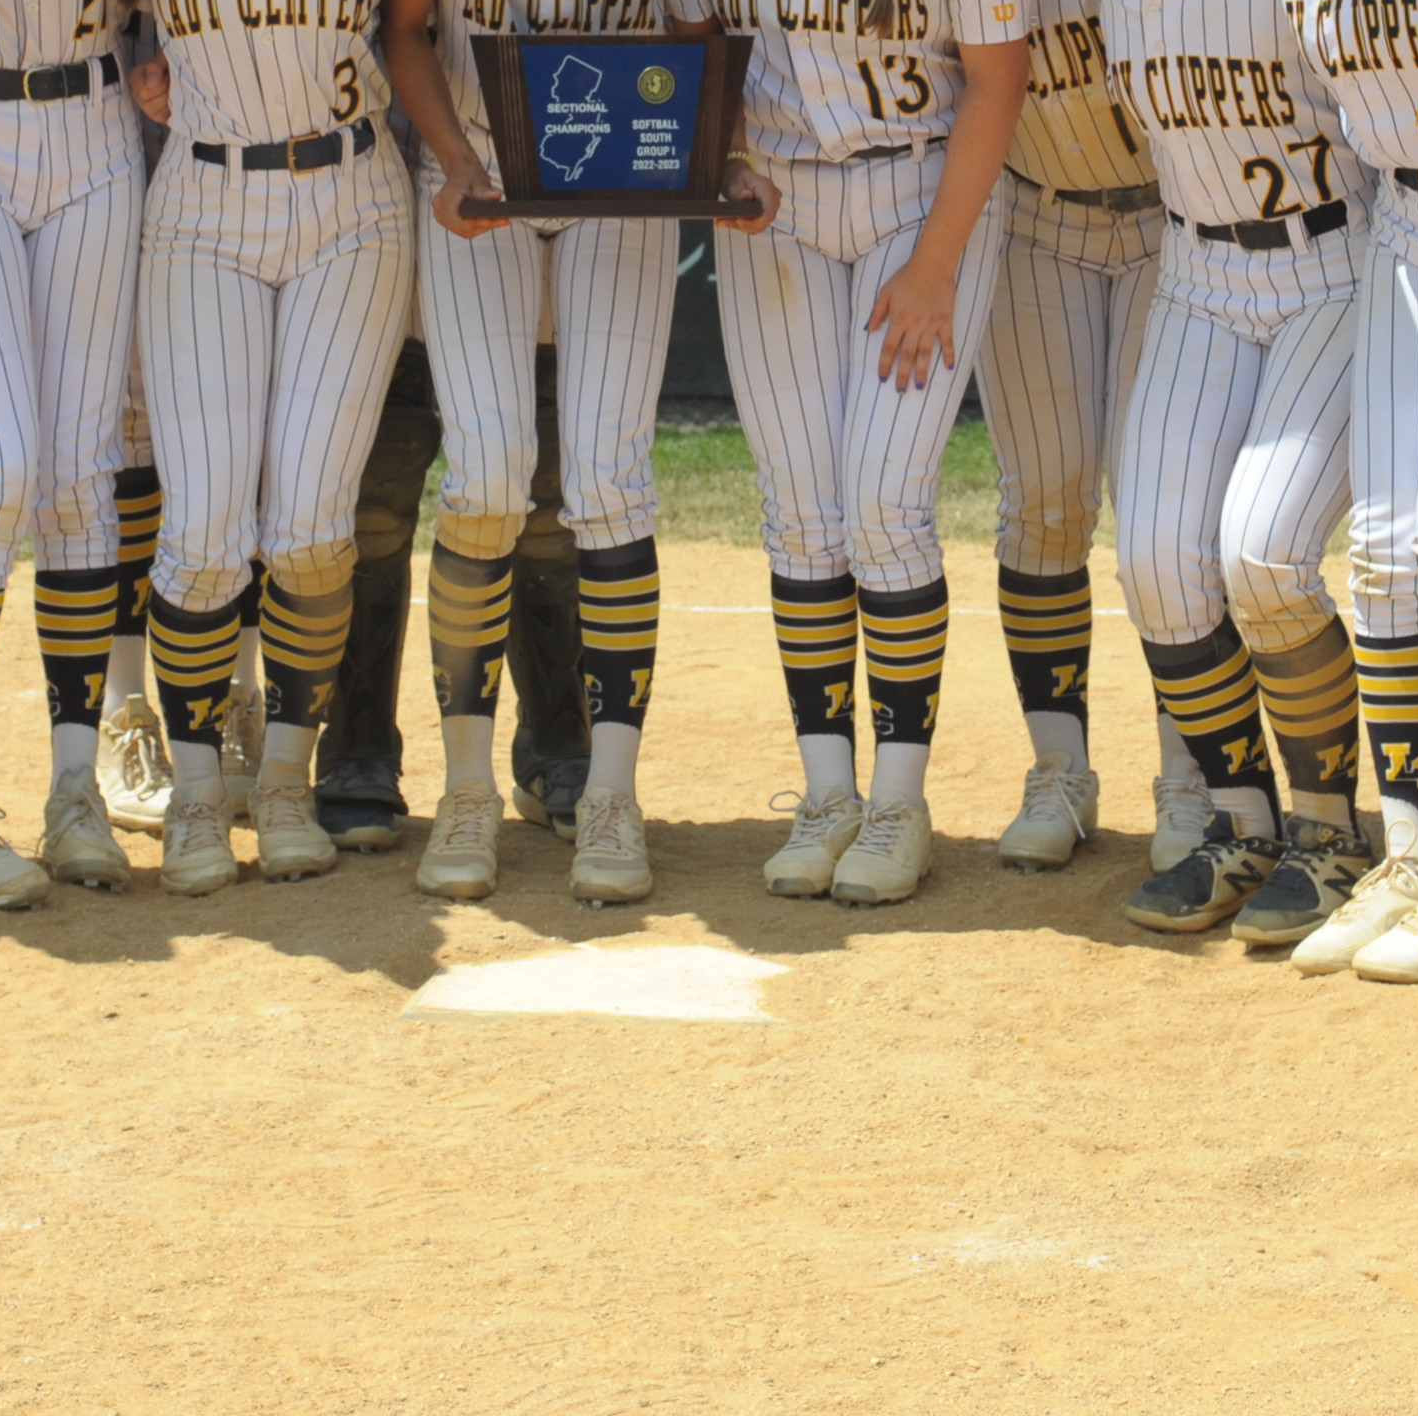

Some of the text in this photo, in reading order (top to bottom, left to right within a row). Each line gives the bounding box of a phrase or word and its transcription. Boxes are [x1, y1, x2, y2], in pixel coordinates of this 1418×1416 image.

[331, 56, 362, 122] 3
[857, 54, 931, 121] 13
[1144, 54, 1295, 131] CLIPPERS
[547, 103, 608, 113] SECTIONAL
[545, 123, 611, 134] CHAMPIONS
[632, 119, 679, 130] SOFTBALL
[639, 133, 672, 143] SOUTH
[637, 146, 670, 156] GROUP
[632, 159, 680, 170] 2022-2023
[1242, 132, 1332, 219] 27
